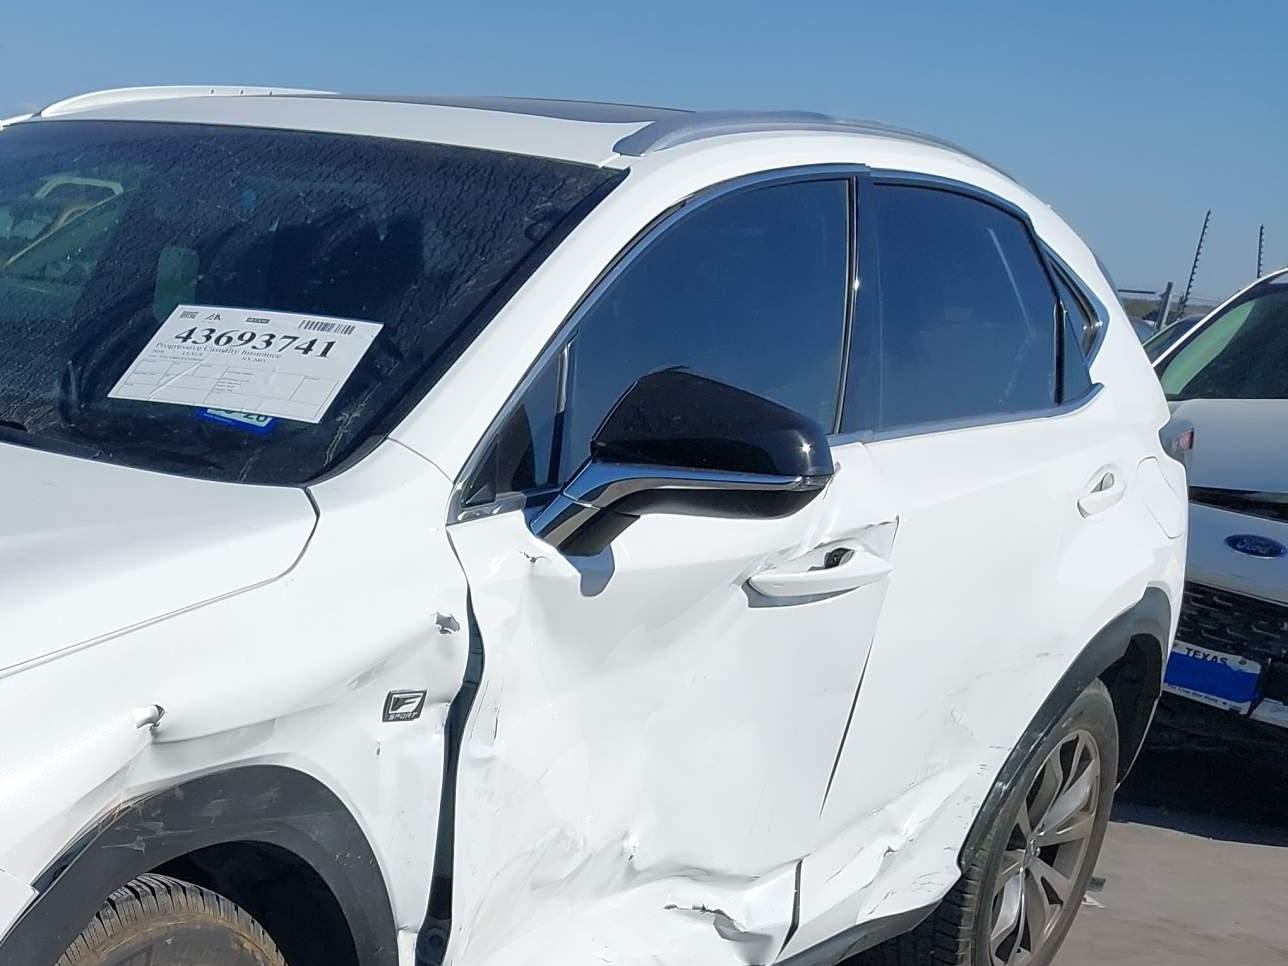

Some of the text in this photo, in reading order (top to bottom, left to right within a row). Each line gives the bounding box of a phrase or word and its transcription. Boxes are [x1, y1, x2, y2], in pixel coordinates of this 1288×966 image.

[154, 341, 202, 352] Progressive
[204, 345, 239, 356] Casualty
[241, 348, 282, 359] Insurance
[175, 326, 337, 359] 43693741
[1185, 647, 1228, 665] TEXAS
[388, 711, 418, 720] SPORT
